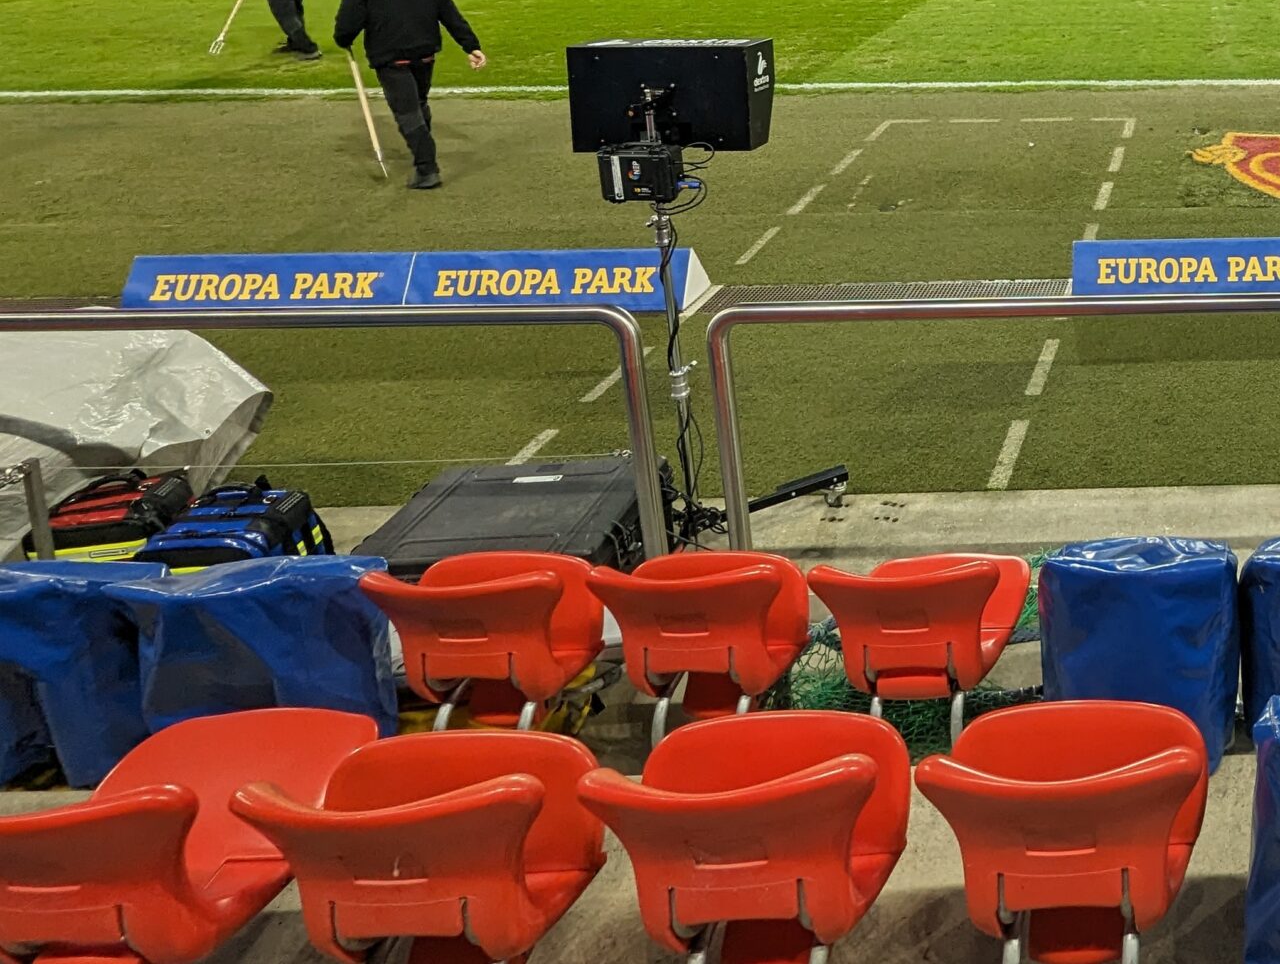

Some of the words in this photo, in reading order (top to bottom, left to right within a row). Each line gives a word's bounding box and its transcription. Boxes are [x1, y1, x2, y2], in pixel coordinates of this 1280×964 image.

[433, 268, 560, 297] EUROPA
[1096, 257, 1217, 284] EUROPA
[148, 273, 280, 301] EUROPA
